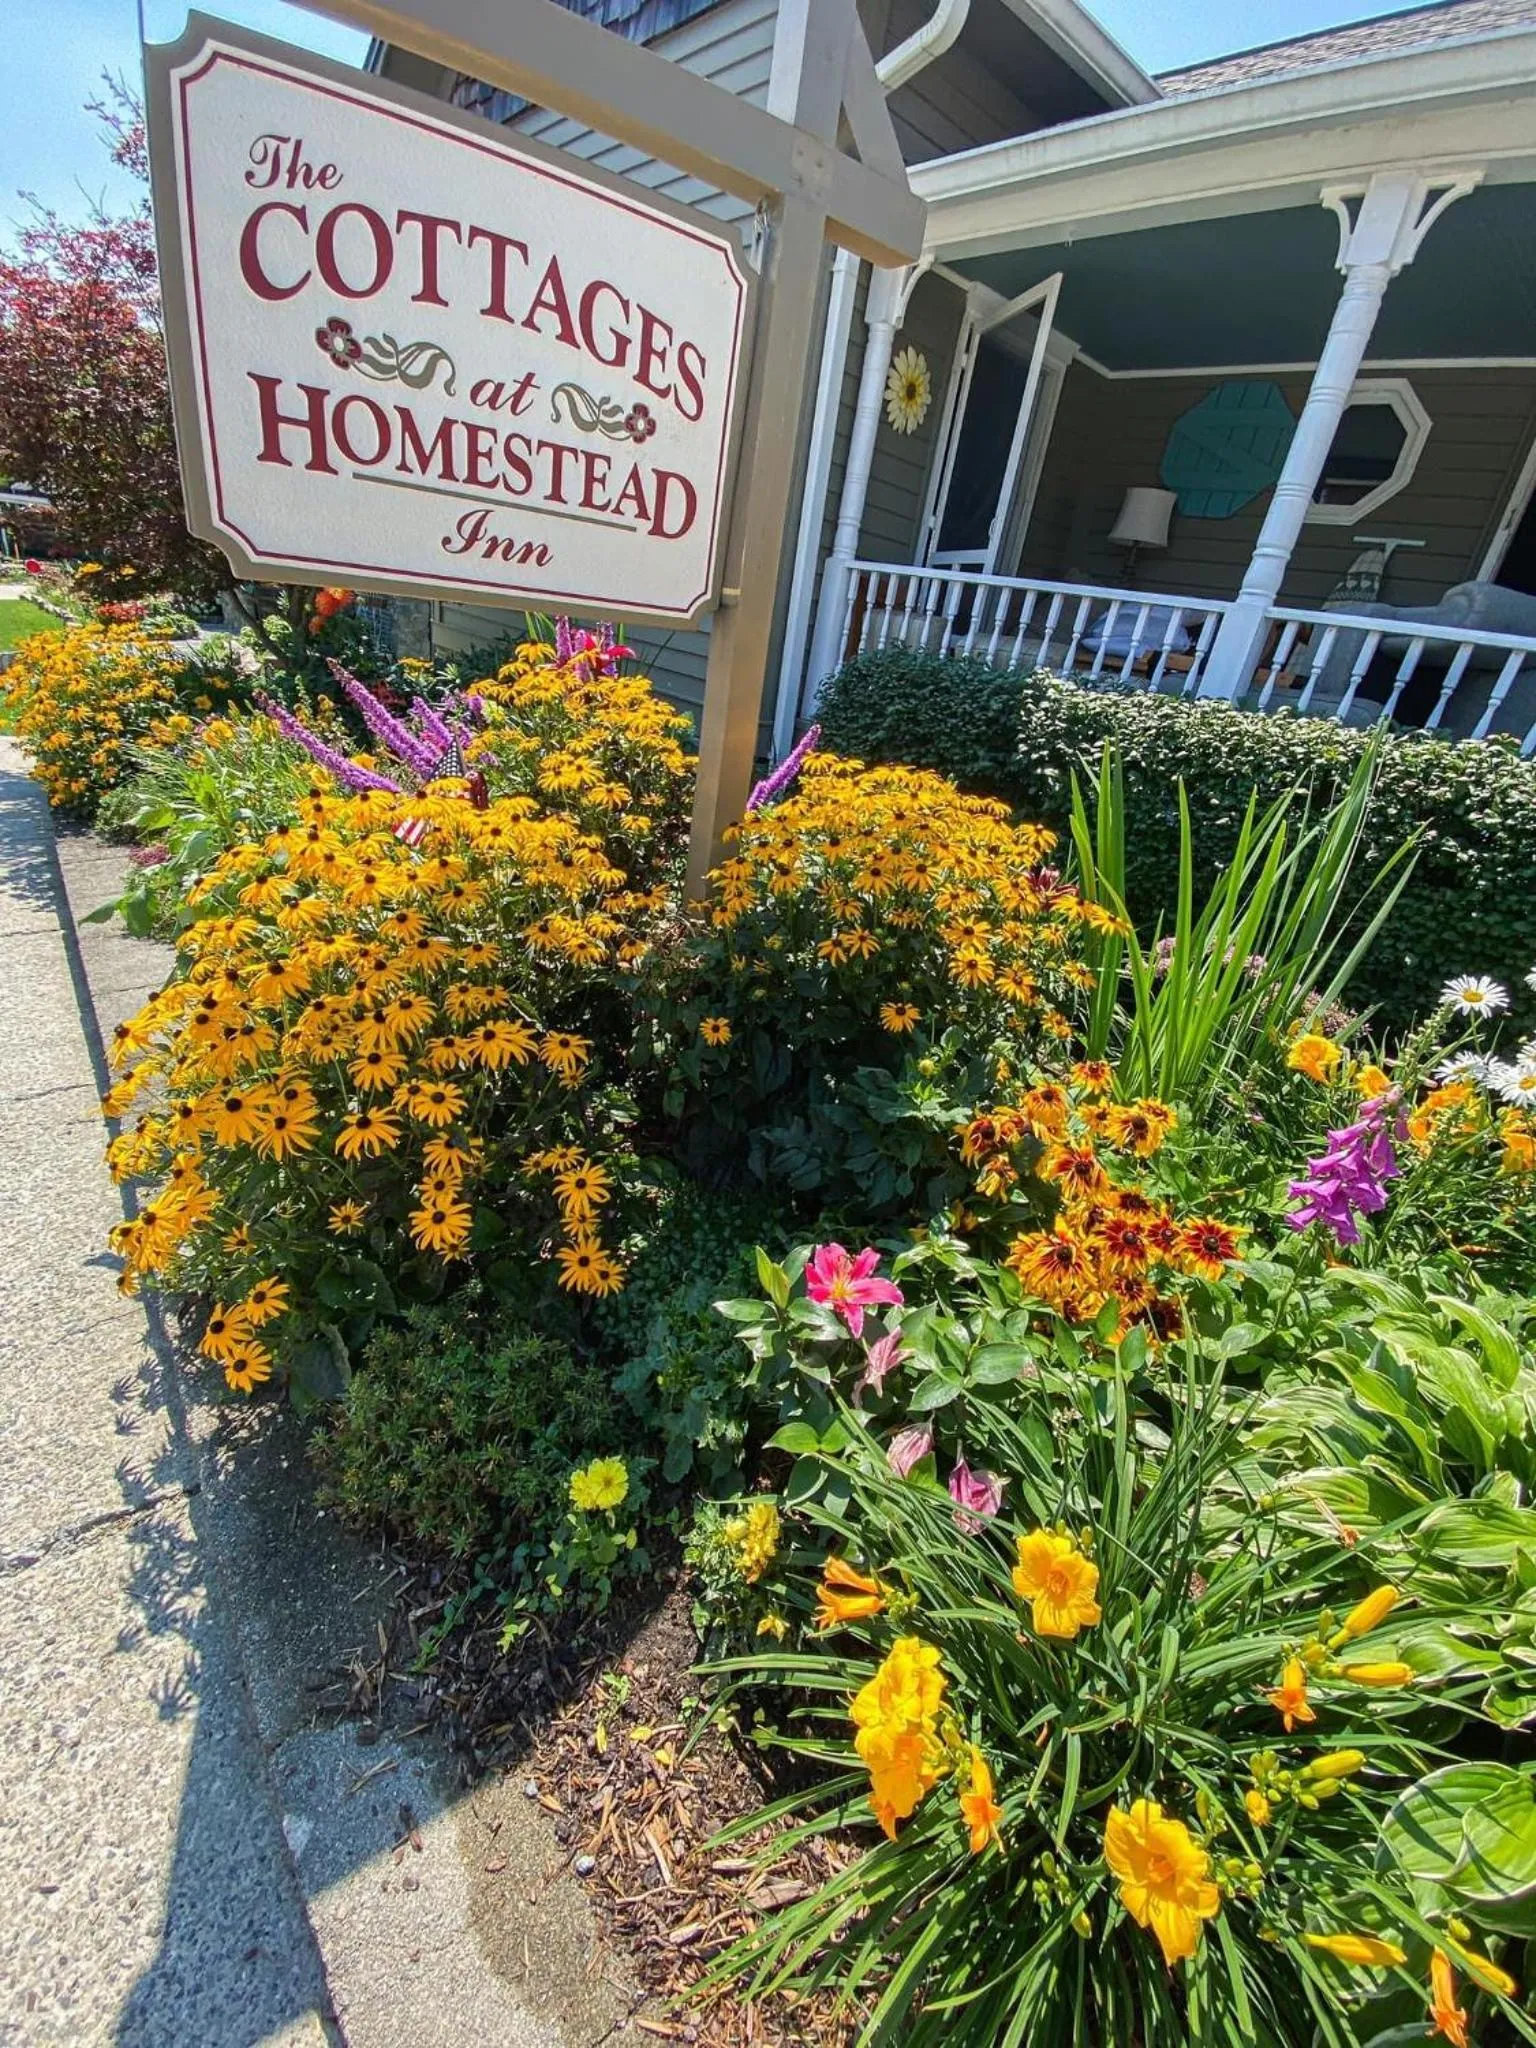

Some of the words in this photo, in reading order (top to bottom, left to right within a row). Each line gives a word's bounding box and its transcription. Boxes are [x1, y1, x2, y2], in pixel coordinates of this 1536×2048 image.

[244, 133, 344, 191] The
[239, 201, 708, 423] COTTAGES
[468, 371, 541, 417] at
[246, 371, 698, 540] HOMESTEAD
[441, 509, 553, 568] Inn
